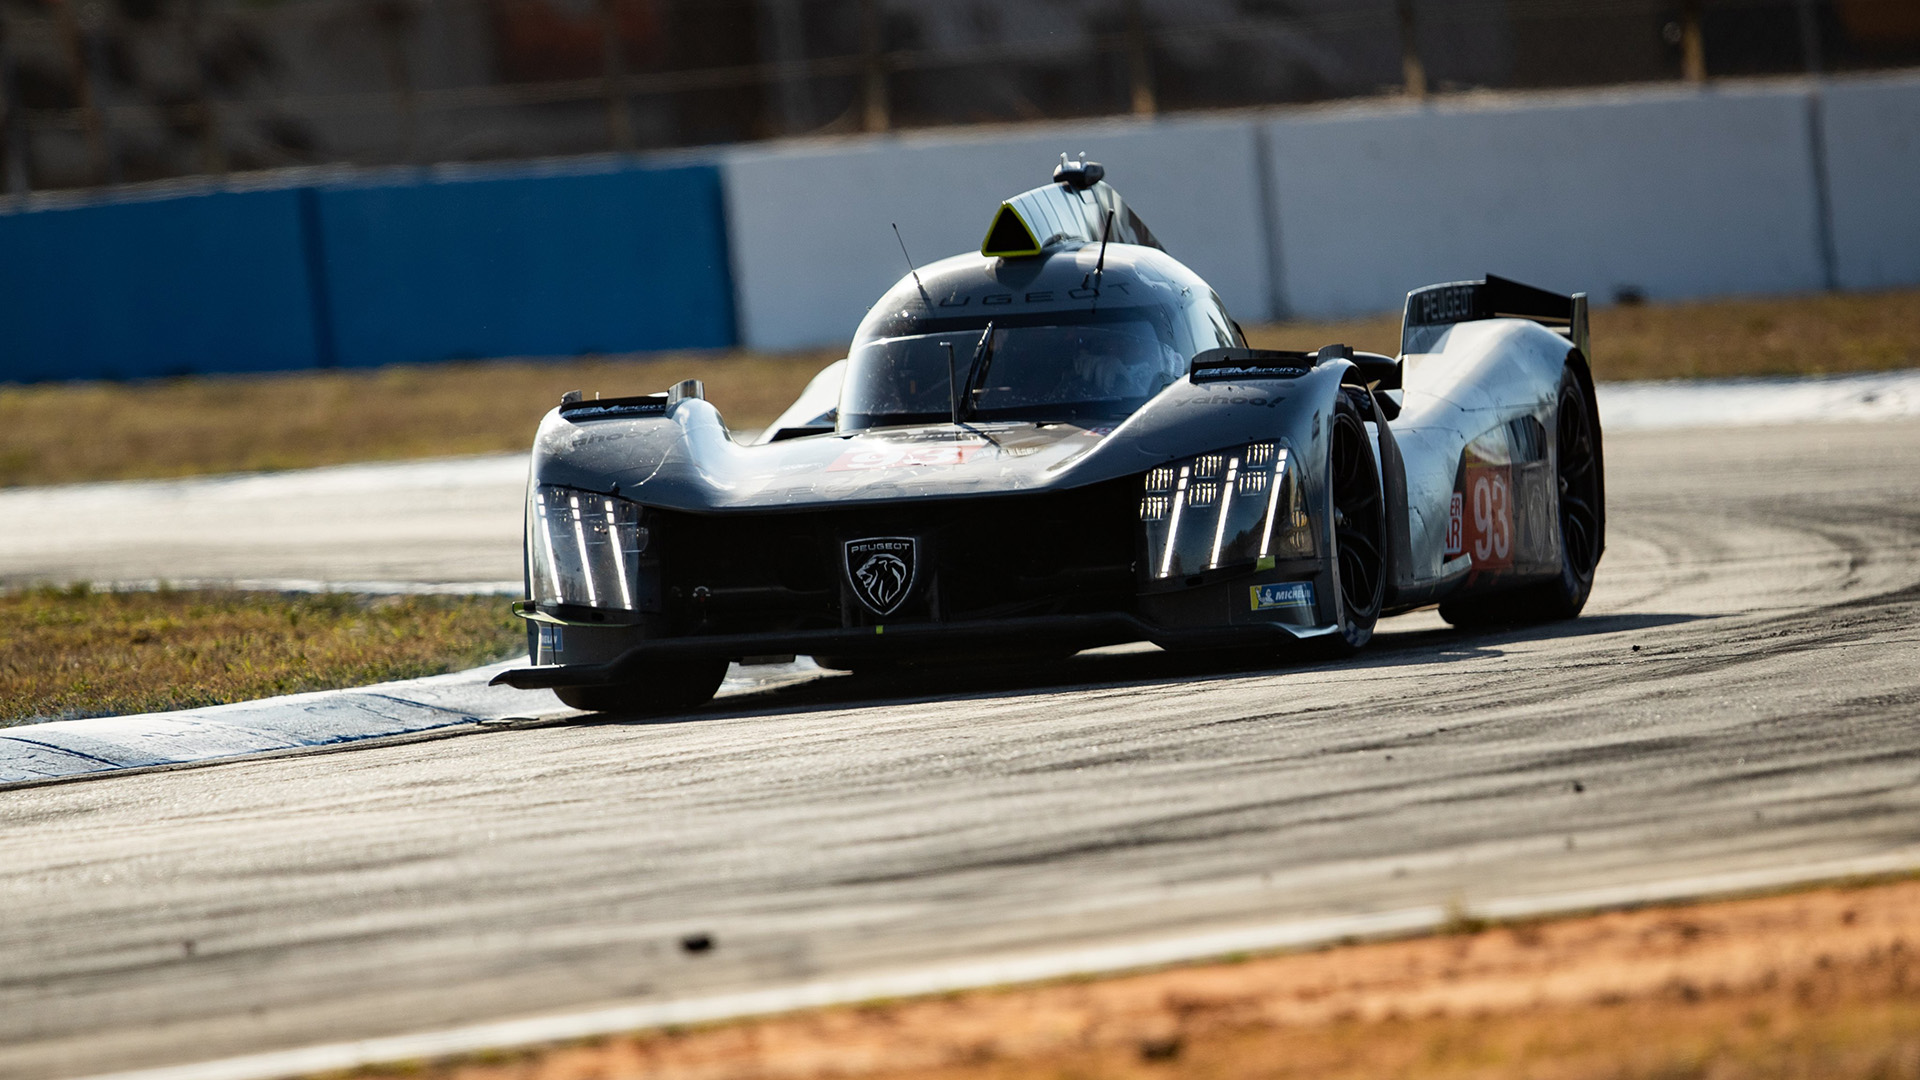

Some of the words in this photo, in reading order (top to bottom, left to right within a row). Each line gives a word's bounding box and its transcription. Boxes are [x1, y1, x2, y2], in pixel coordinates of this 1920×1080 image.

[1423, 287, 1474, 323] PEUGEOT
[1175, 394, 1286, 408] yahoo!
[1474, 474, 1509, 560] 93
[851, 543, 910, 553] PEUGEOT
[1275, 589, 1311, 600] MICHELIN
